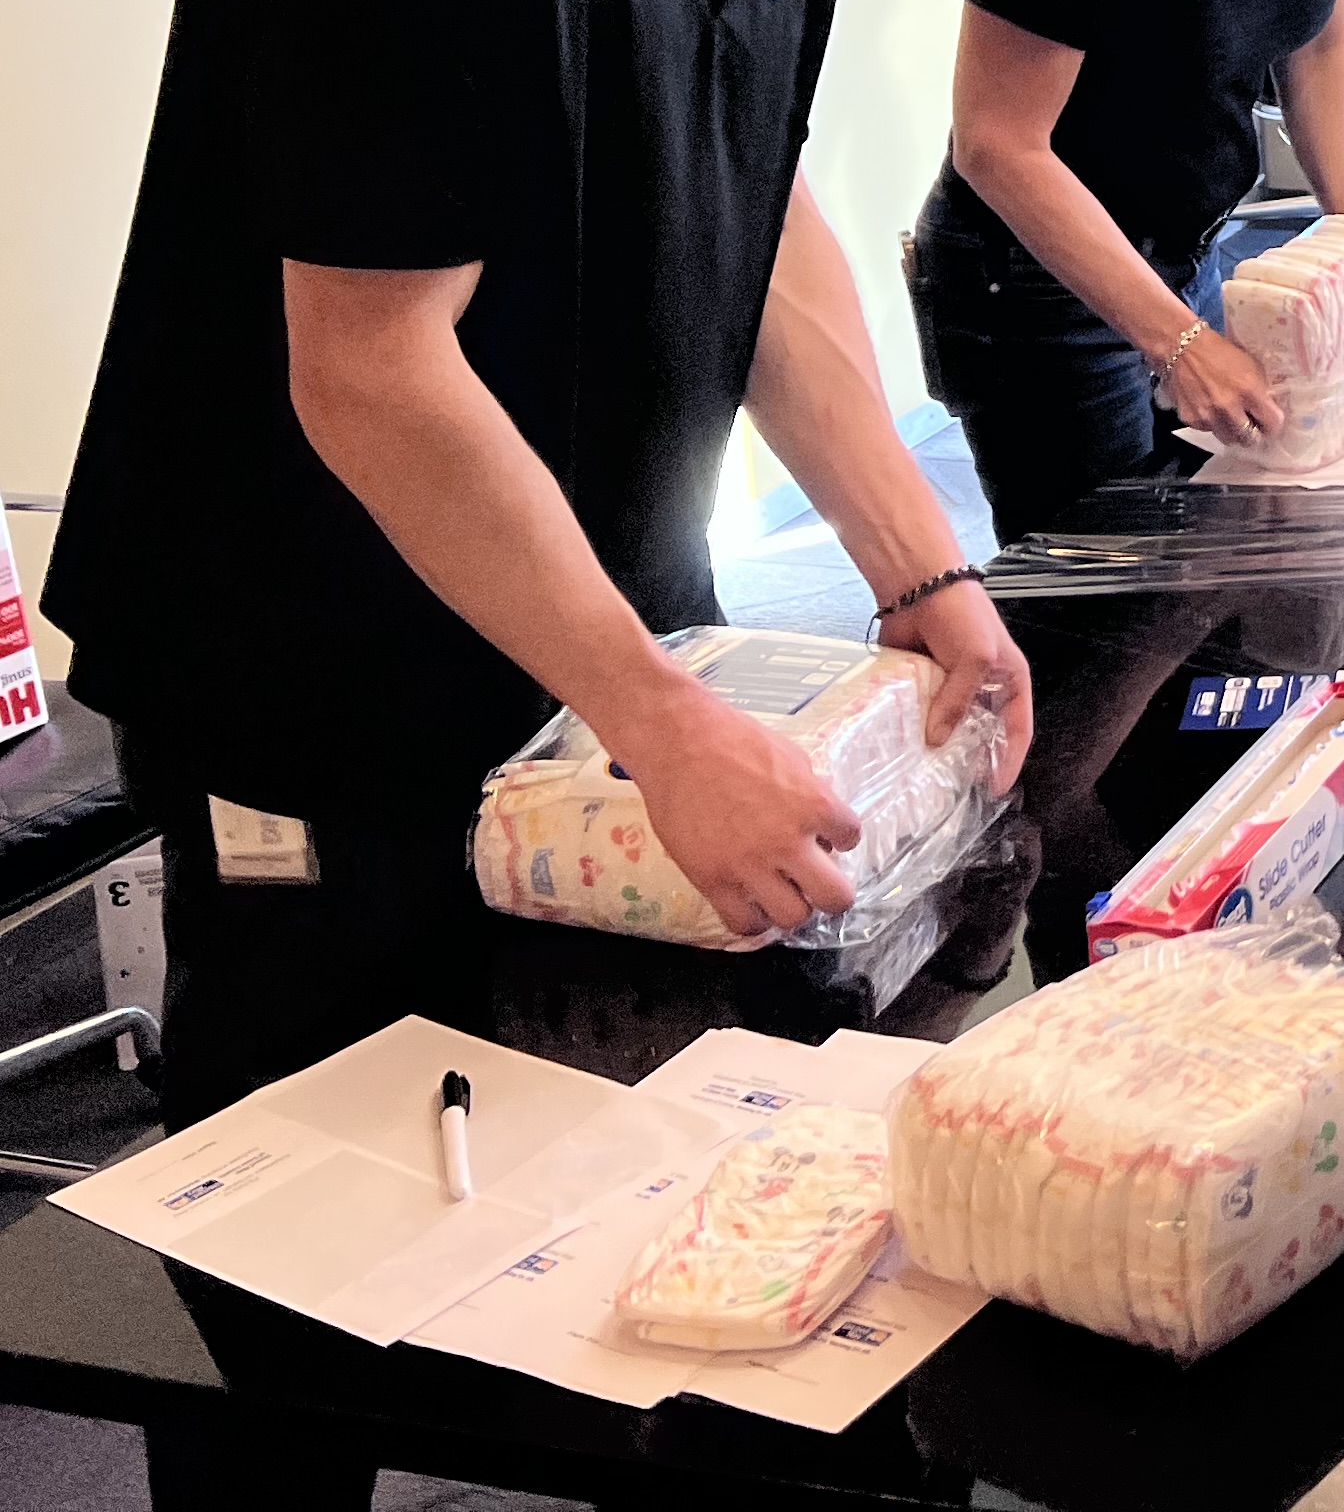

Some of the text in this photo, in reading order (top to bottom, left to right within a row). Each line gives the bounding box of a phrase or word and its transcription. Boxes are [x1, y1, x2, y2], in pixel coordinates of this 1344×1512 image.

[1258, 813, 1327, 901] Slide Cutter
[107, 880, 131, 908] 3
